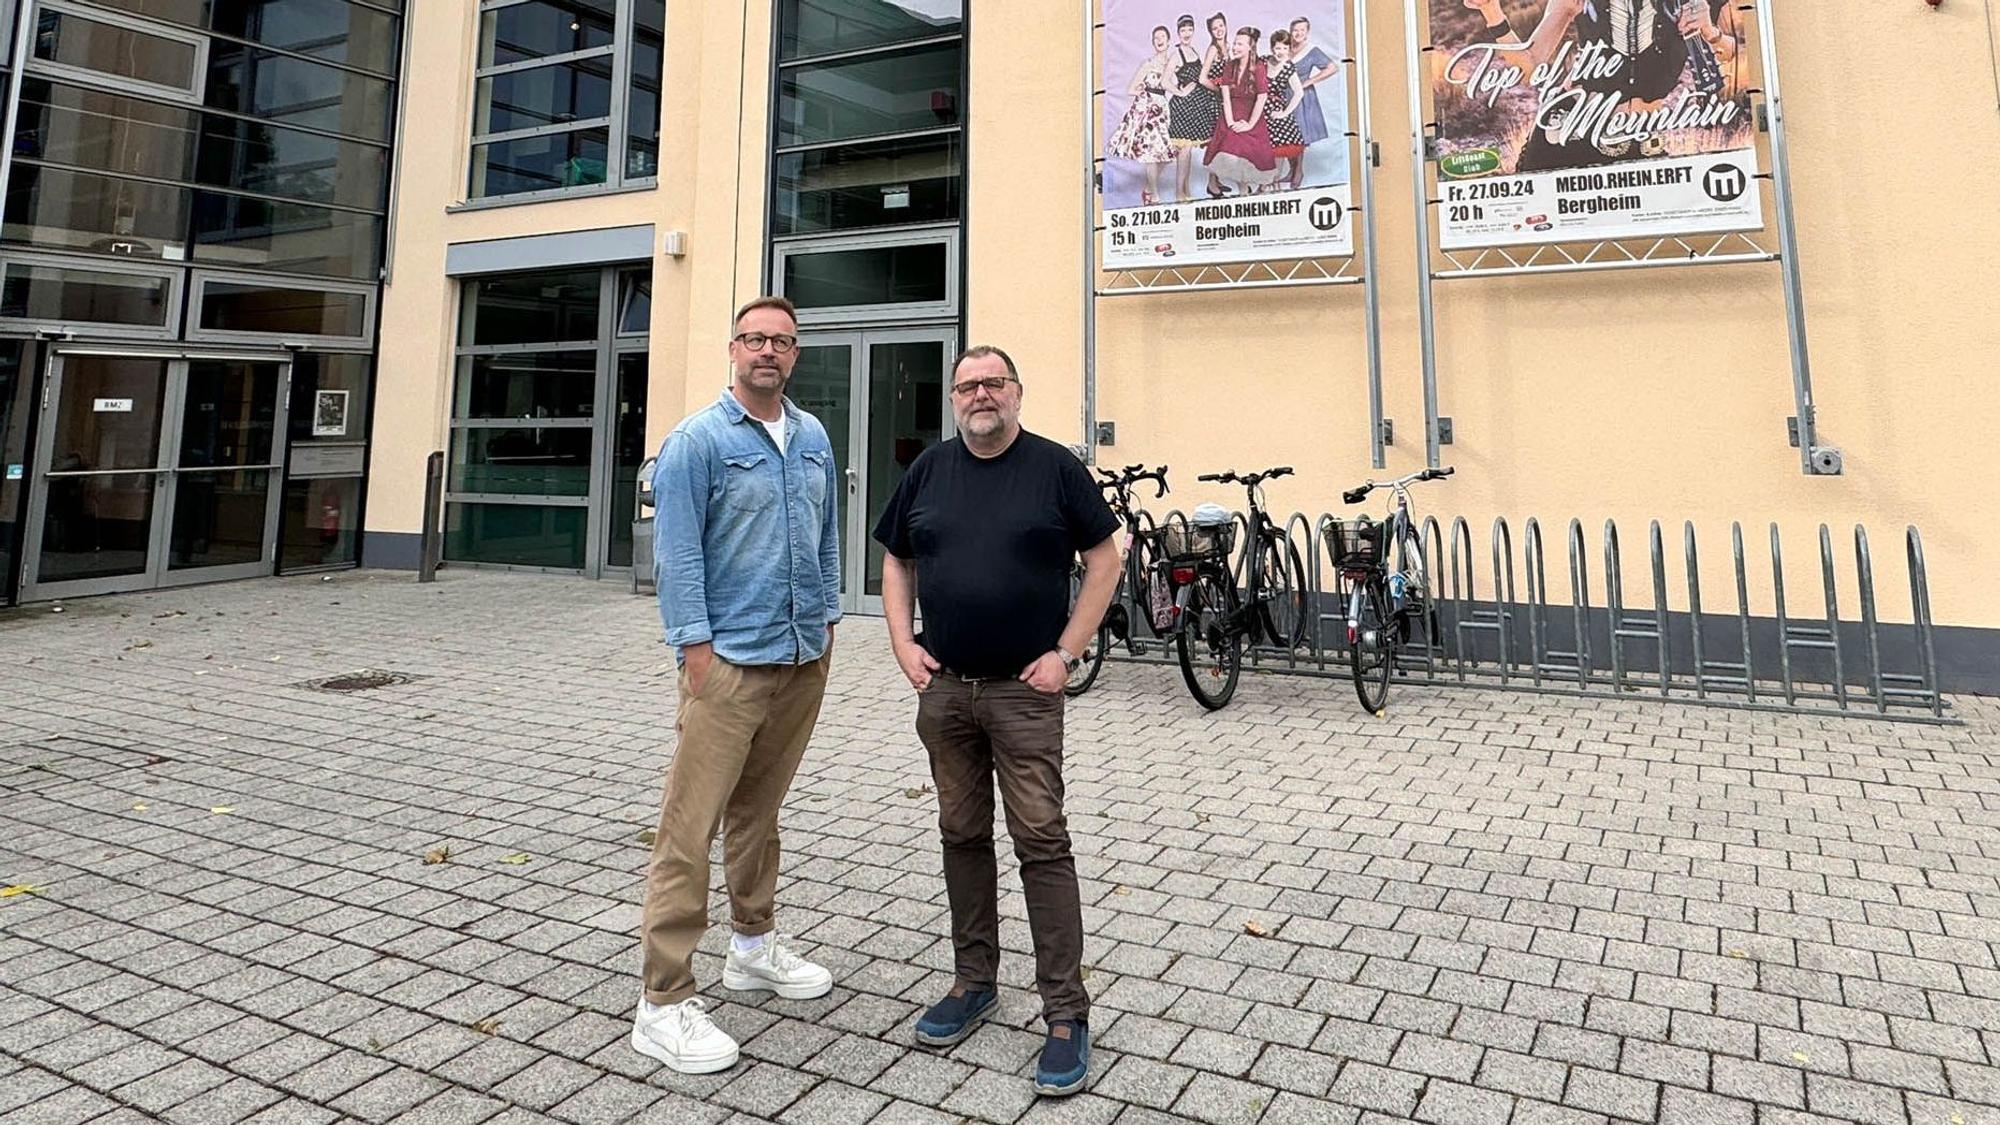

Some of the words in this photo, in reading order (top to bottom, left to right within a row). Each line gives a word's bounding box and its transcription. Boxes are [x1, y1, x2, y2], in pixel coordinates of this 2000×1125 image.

[1444, 40, 1533, 108] Top
[1530, 41, 1573, 104] of
[1570, 40, 1623, 83] the
[1535, 89, 1739, 147] Mountain
[1556, 166, 1693, 193] MEDIO.RHEIN.ERFT
[1448, 186, 1466, 201] Fr.
[1469, 180, 1534, 200] 27.09.24
[1195, 199, 1302, 221] MEDIO.RHEIN.ERFT
[1449, 205, 1469, 222] 20
[1473, 204, 1483, 220] h
[1557, 194, 1641, 215] Bergheim
[1111, 214, 1130, 228] So.
[1132, 209, 1180, 226] 27.10.24
[1111, 231, 1125, 246] 15
[1128, 231, 1136, 245] h
[1195, 222, 1261, 240] Bergheim
